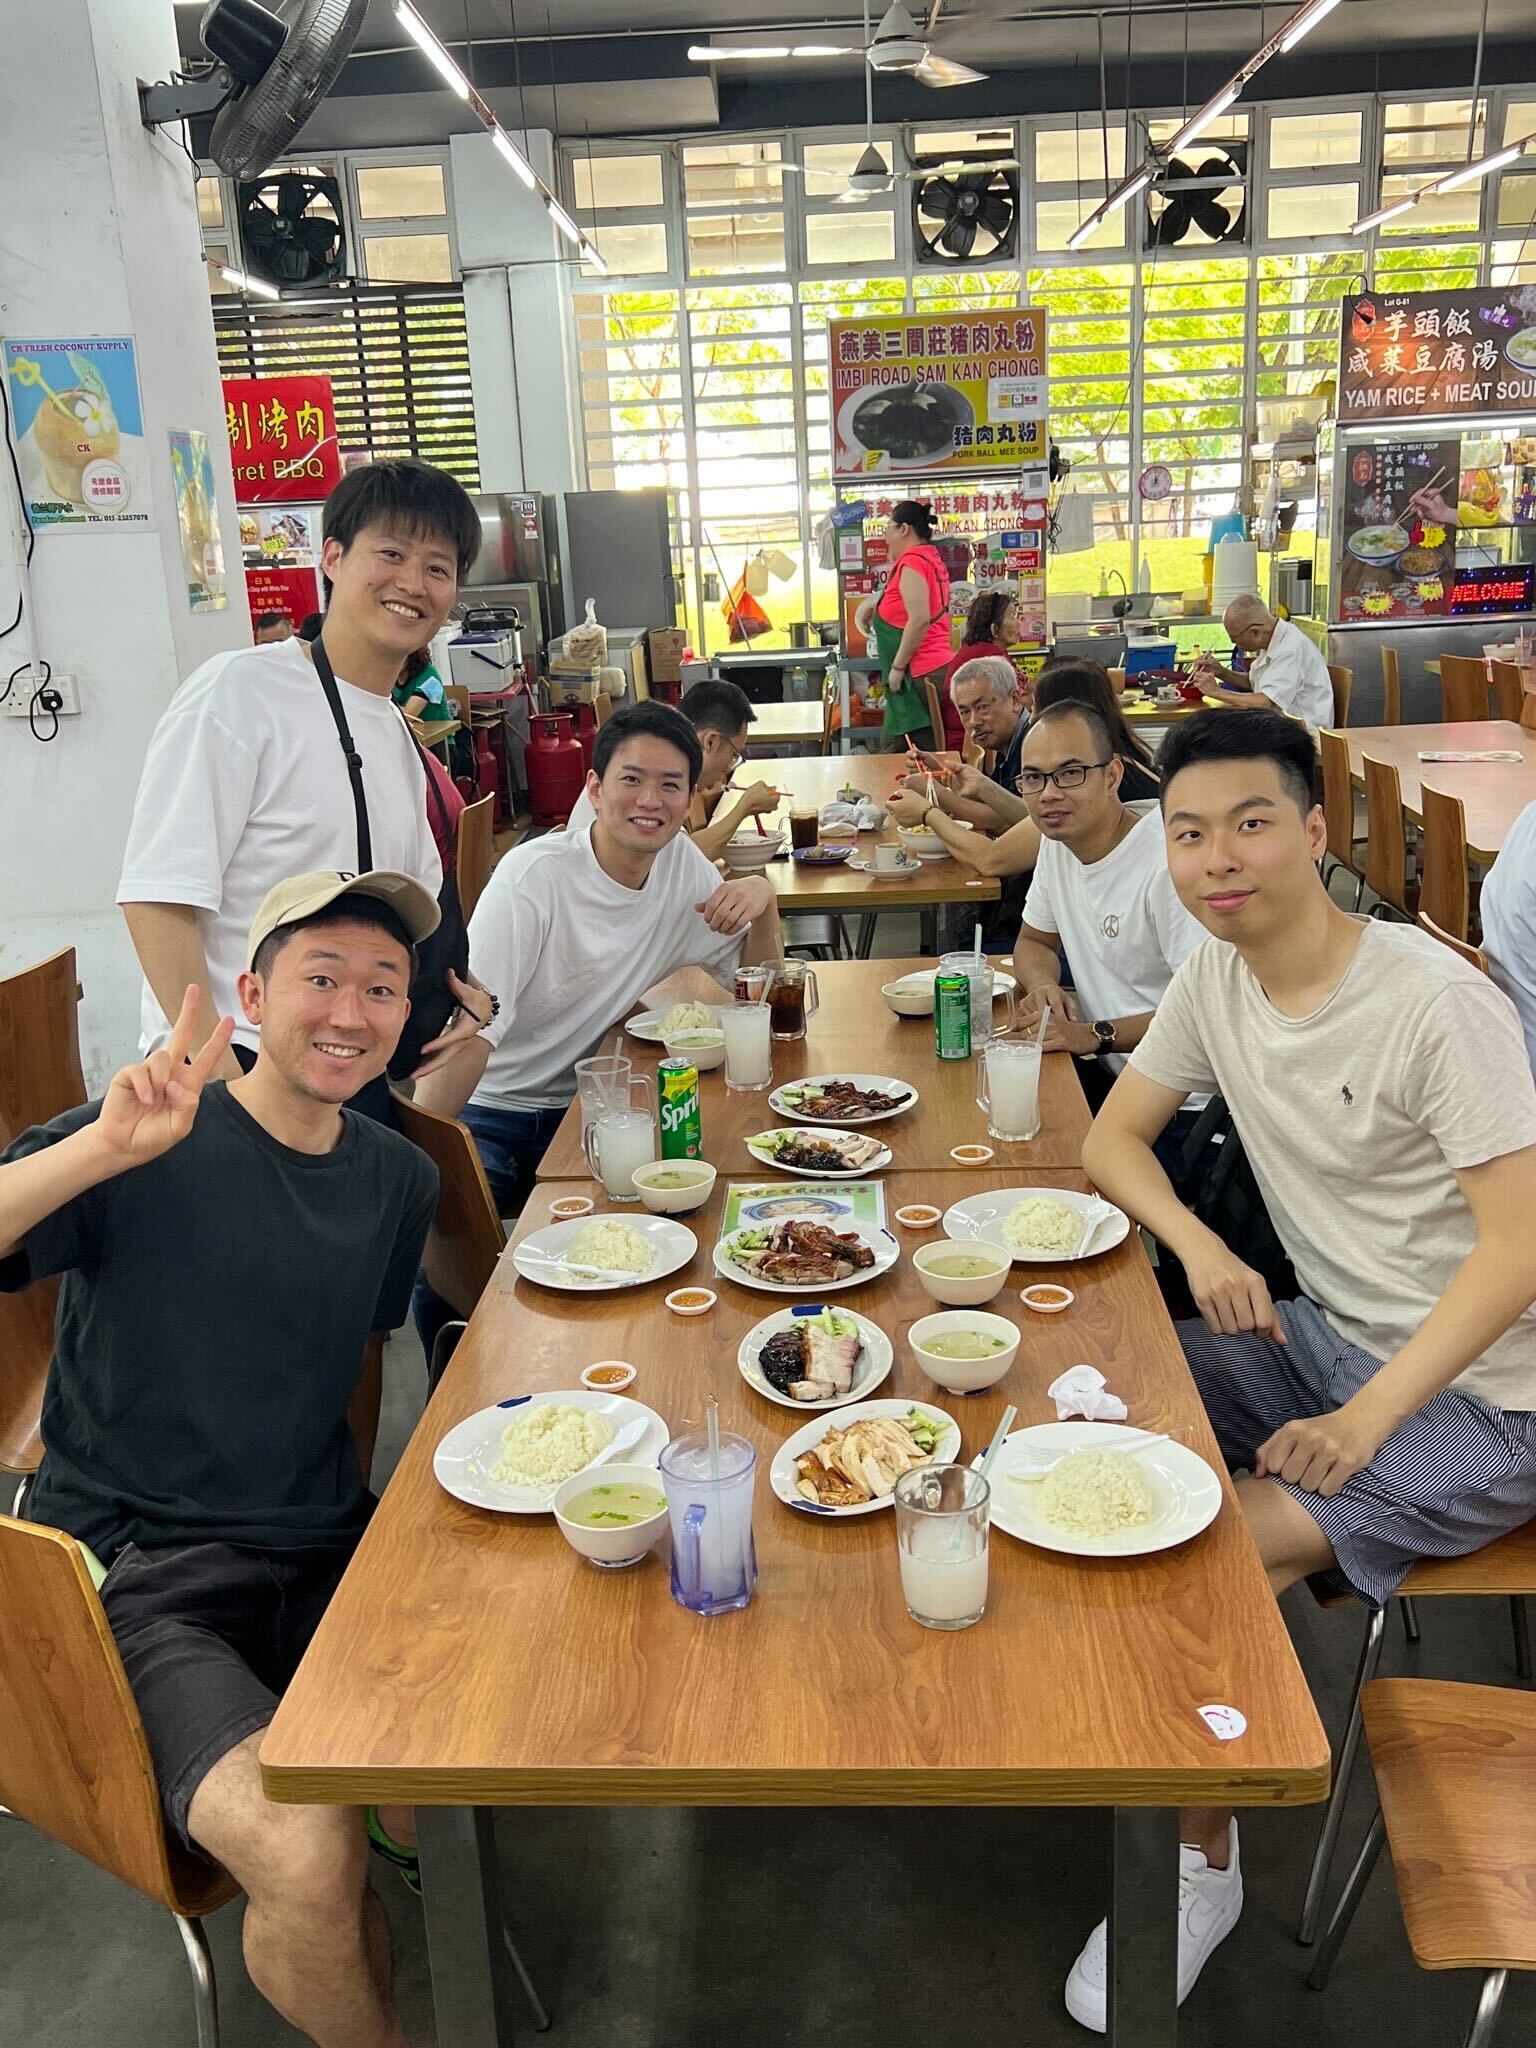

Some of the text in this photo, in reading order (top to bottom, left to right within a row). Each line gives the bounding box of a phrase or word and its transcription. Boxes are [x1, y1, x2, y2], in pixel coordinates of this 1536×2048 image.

[1384, 307, 1473, 342] 芋頭飯
[25, 344, 53, 352] FRESH
[54, 343, 94, 352] COCONUT
[96, 342, 128, 351] SUPPLY
[1348, 339, 1500, 378] 咸菜豆腐湯
[838, 359, 1039, 388] IMBI ROAD SAM KAN CHONG
[1346, 388, 1380, 408] YAM
[1386, 385, 1426, 406] RICE
[1445, 382, 1492, 402] MEAT
[953, 422, 1036, 447] 猪肉丸粉
[77, 444, 91, 453] CK
[953, 446, 1039, 459] PORK BALL MEE SOUP
[273, 457, 325, 480] BBQ
[956, 518, 978, 533] KAN
[984, 516, 1023, 531] CHONG
